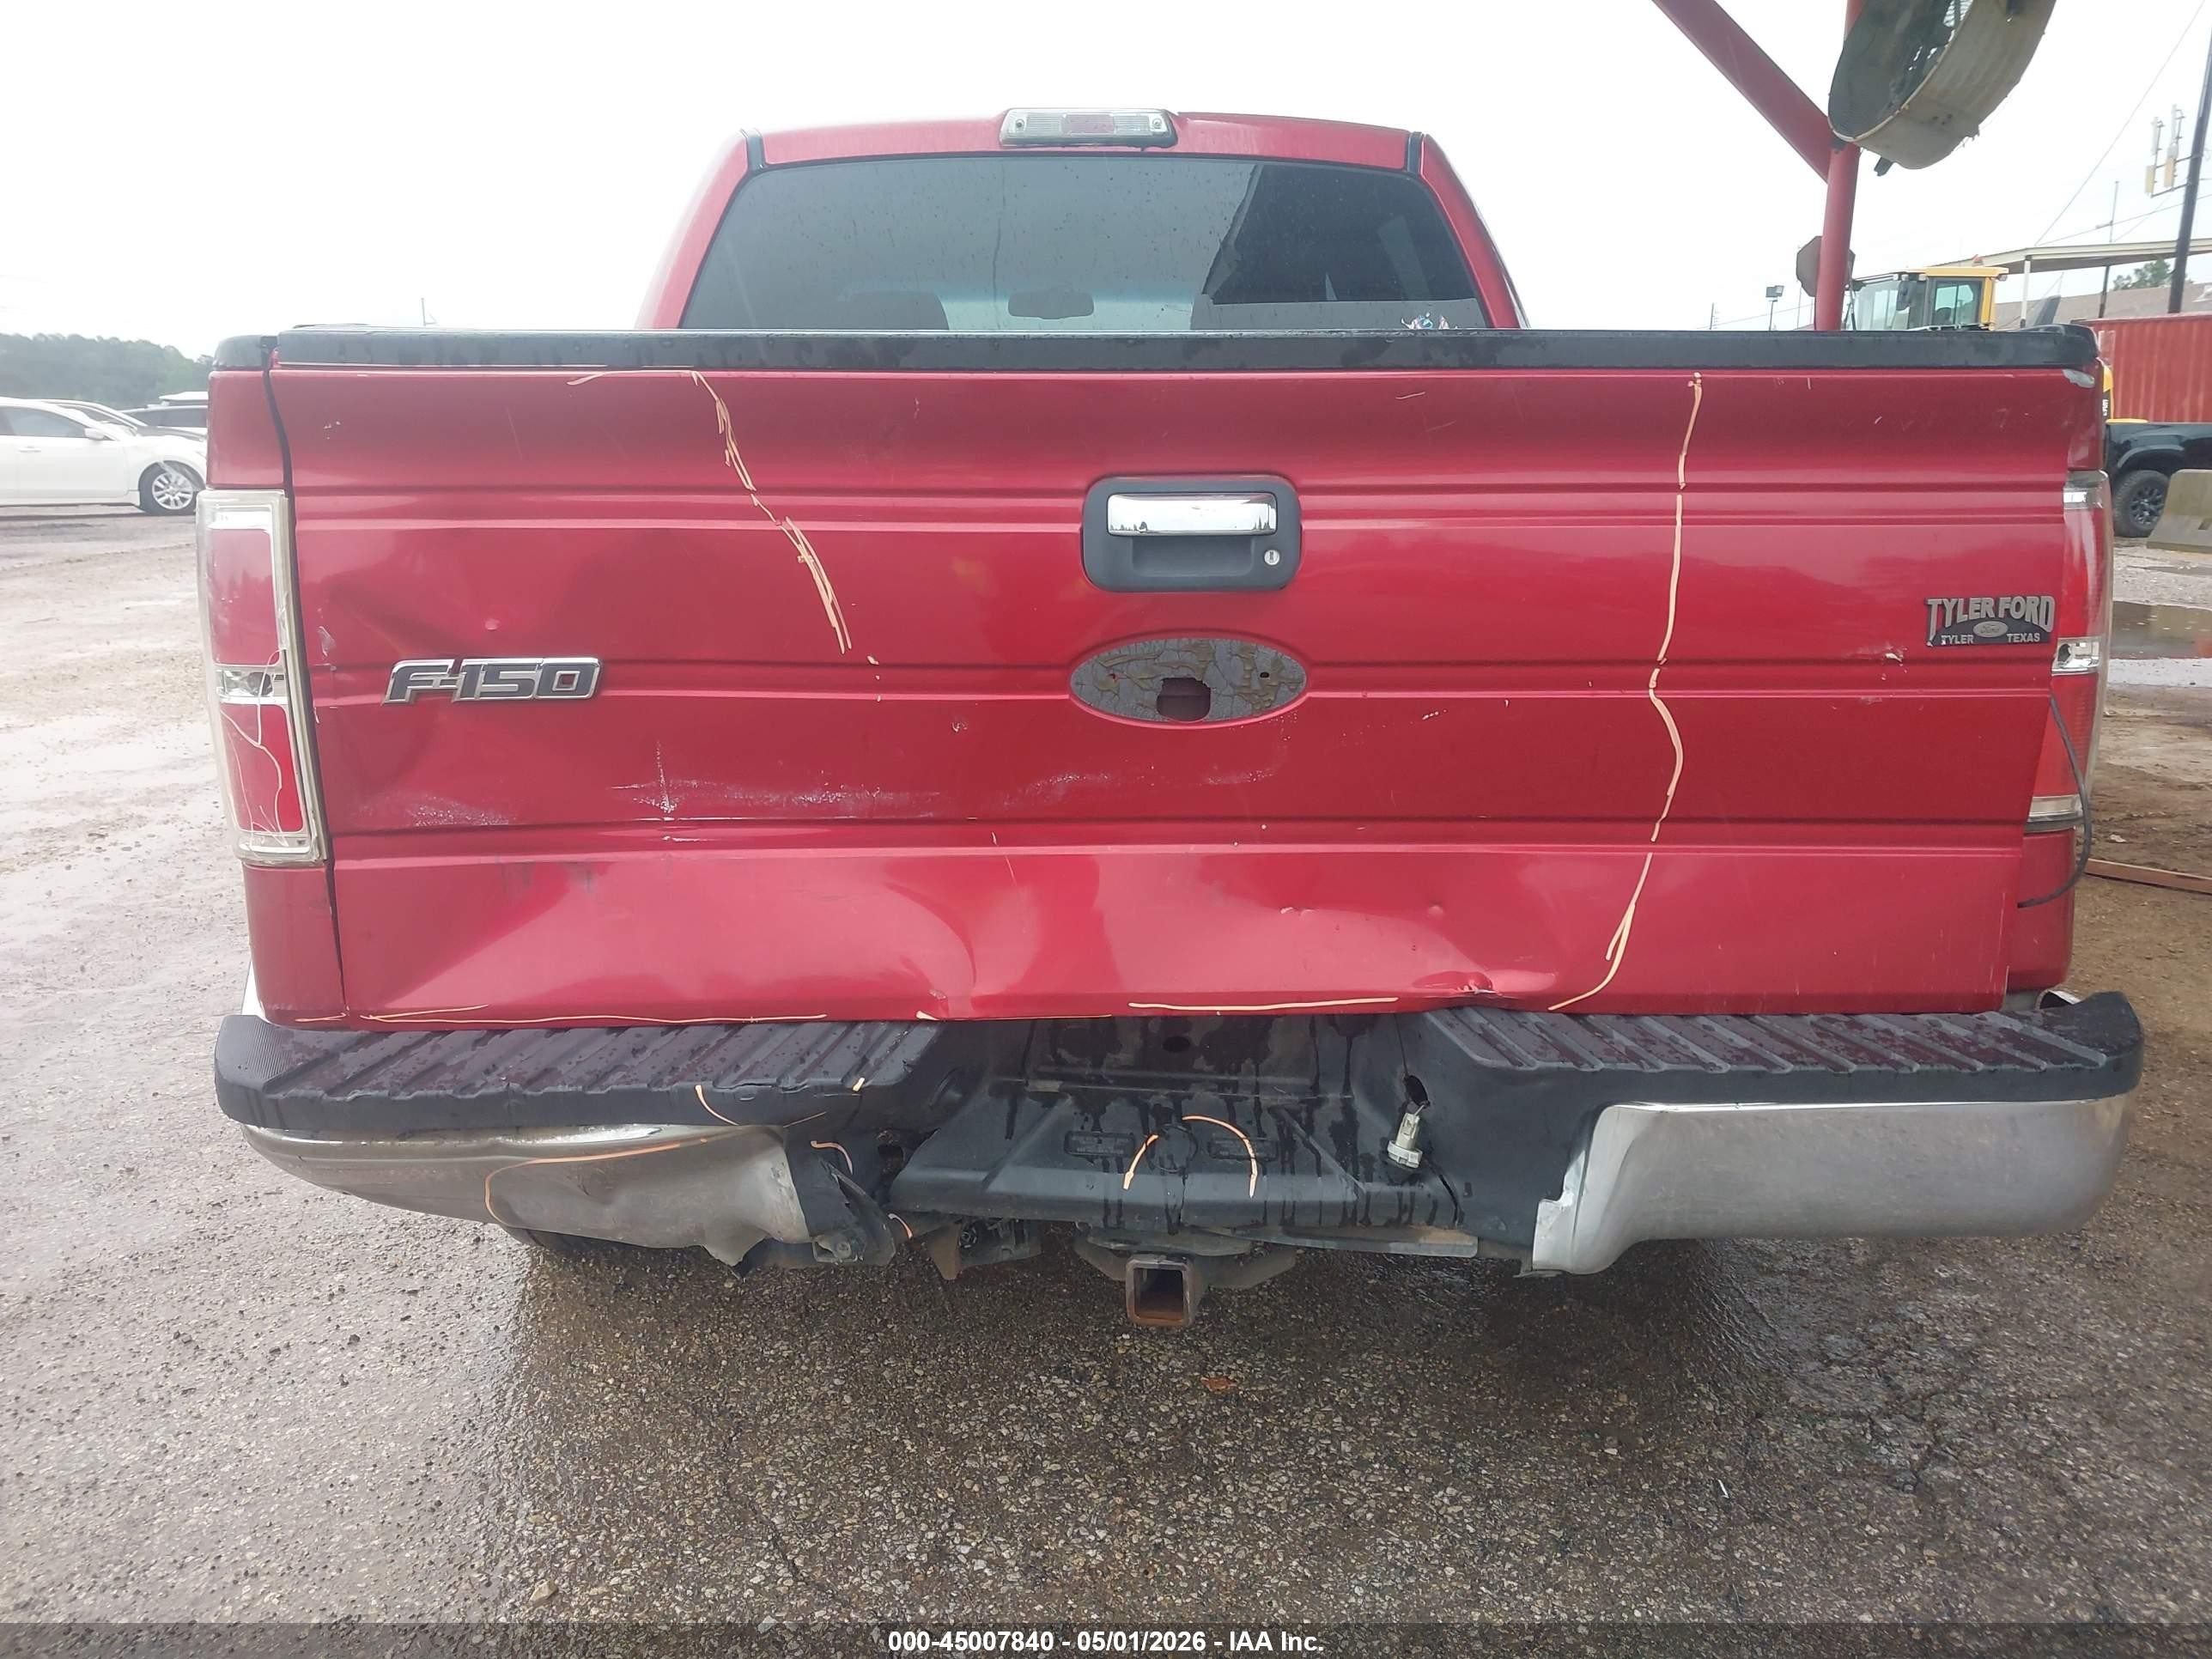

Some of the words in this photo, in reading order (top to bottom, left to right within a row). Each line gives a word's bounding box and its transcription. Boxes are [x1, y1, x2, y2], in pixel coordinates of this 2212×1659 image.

[1926, 596, 1996, 646] TYLER
[1997, 595, 2056, 633] FORD
[1941, 634, 1974, 645] TYLER
[2006, 632, 2040, 643] TEXAS
[382, 657, 600, 704] F-150
